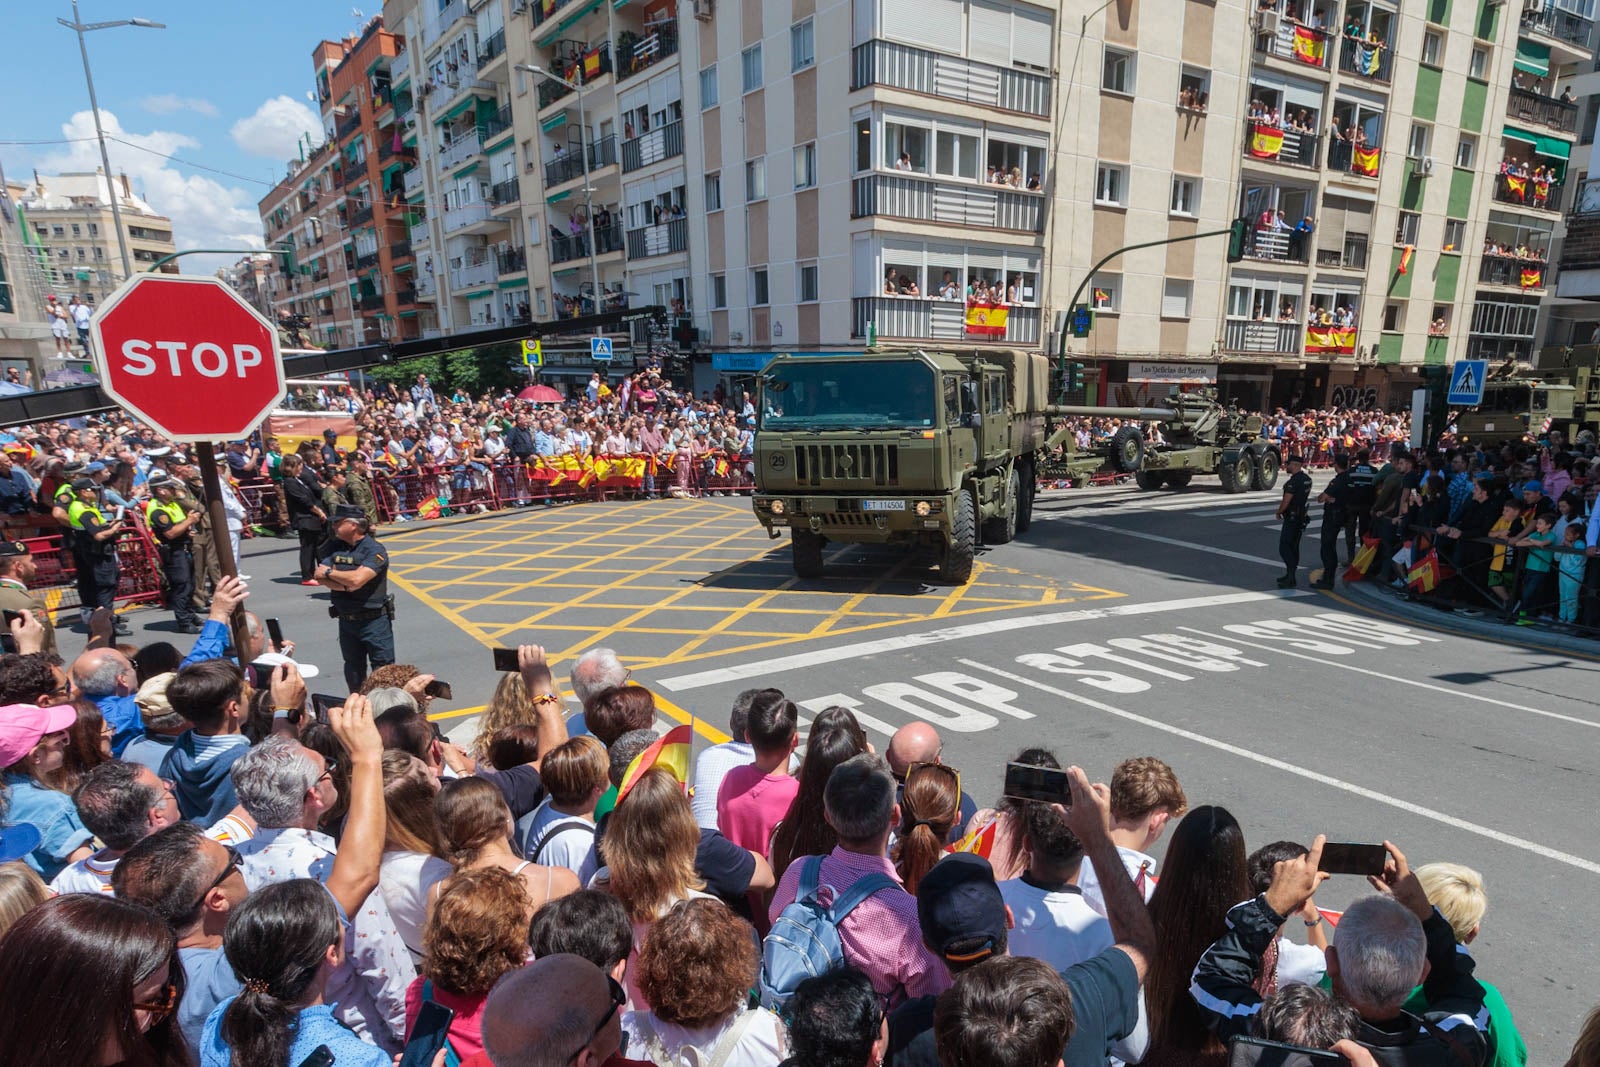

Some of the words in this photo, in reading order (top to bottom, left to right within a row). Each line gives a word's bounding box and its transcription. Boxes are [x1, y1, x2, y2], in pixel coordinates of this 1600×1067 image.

[121, 338, 262, 379] STOP
[1141, 365, 1151, 373] Las
[1152, 366, 1177, 374] Delicias
[1177, 366, 1187, 374] del
[1187, 367, 1207, 375] Barrio
[772, 455, 785, 467] 29
[867, 501, 876, 510] ET
[880, 500, 904, 510] 114504
[1222, 613, 1443, 655] STOP
[1015, 633, 1269, 694] STOP
